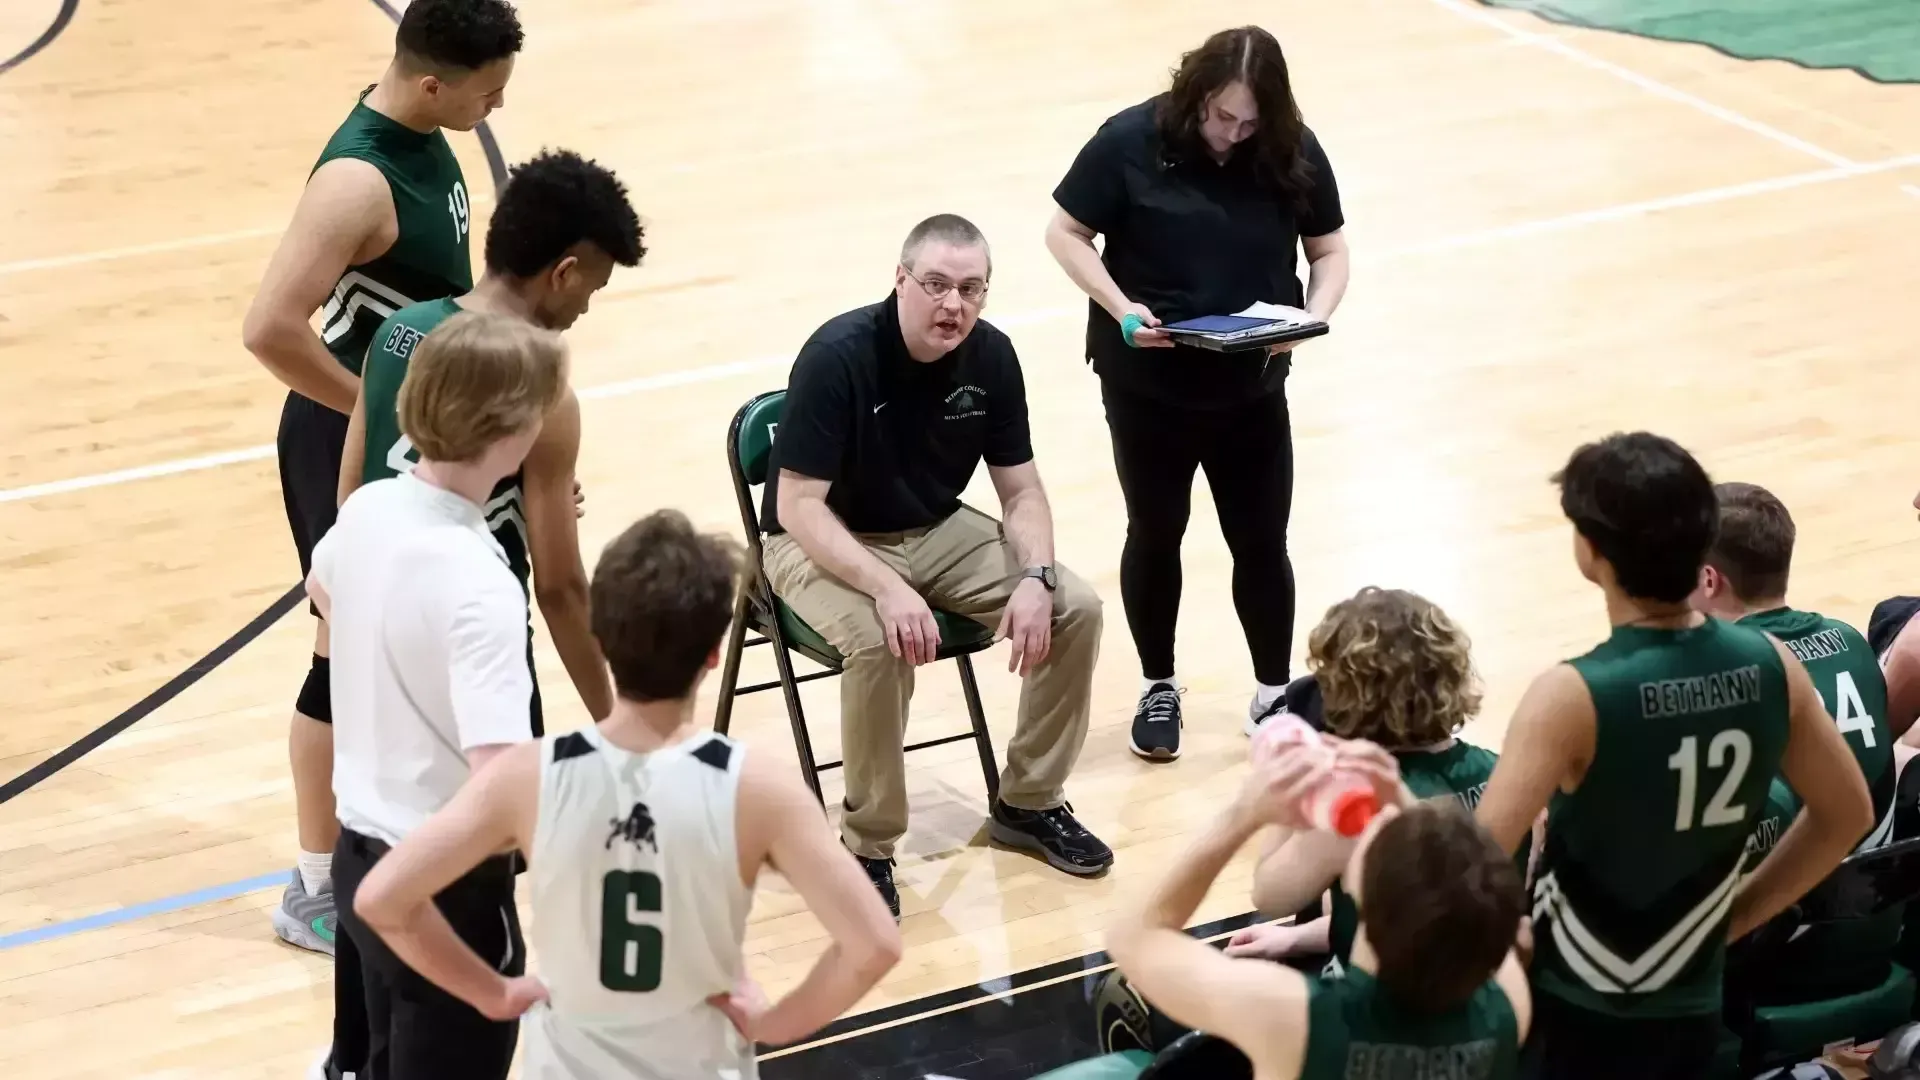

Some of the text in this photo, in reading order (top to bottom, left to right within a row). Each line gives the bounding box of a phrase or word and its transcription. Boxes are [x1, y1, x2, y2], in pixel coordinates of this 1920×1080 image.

[448, 181, 469, 244] 19
[944, 385, 987, 403] BETHANY COLLEGE
[1784, 628, 1849, 662] HANY
[1640, 664, 1761, 719] BETHANY
[1814, 670, 1877, 749] 4
[1668, 728, 1752, 832] 12
[600, 869, 663, 992] 6
